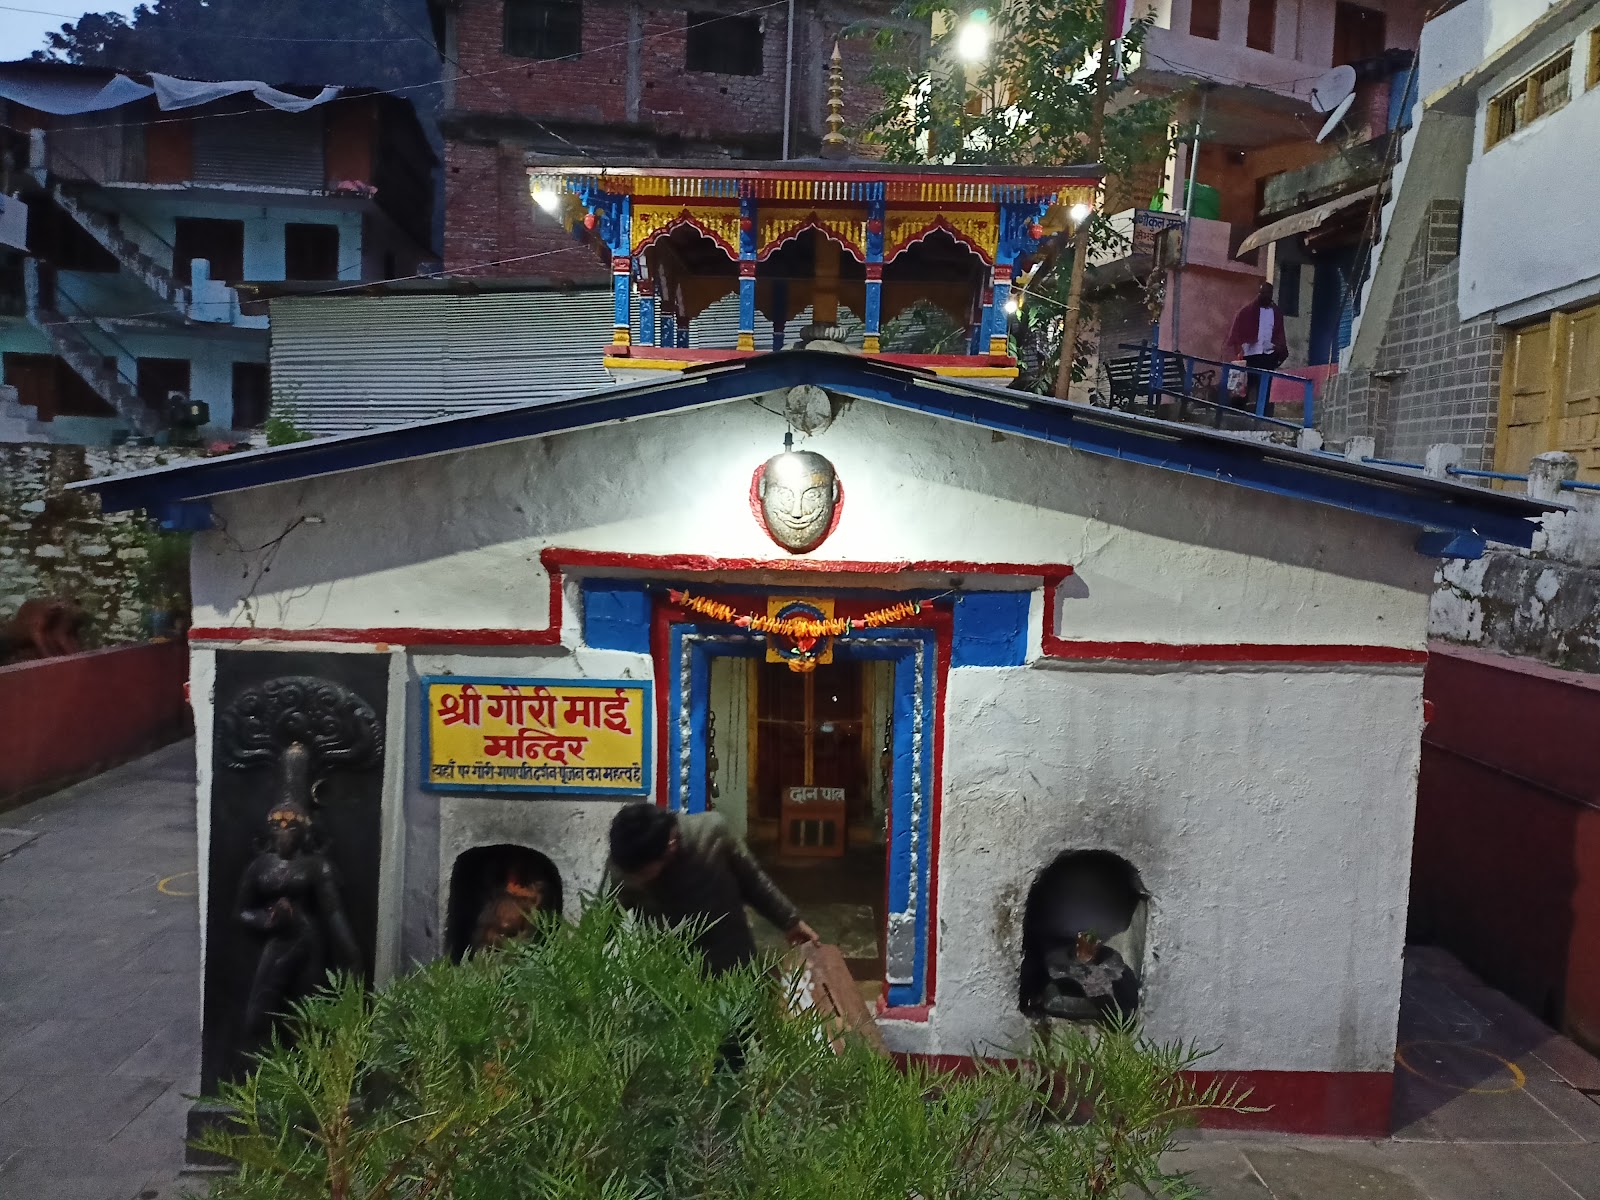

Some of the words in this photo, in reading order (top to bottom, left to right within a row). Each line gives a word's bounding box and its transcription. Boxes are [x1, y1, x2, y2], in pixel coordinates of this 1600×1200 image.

[438, 684, 482, 725] श्री
[487, 685, 558, 728] गौरी
[562, 687, 632, 735] माई
[484, 727, 589, 764] मन्दिर
[432, 759, 455, 779] यहाँ
[457, 765, 470, 779] पर
[585, 767, 602, 781] का
[789, 786, 818, 804] दान
